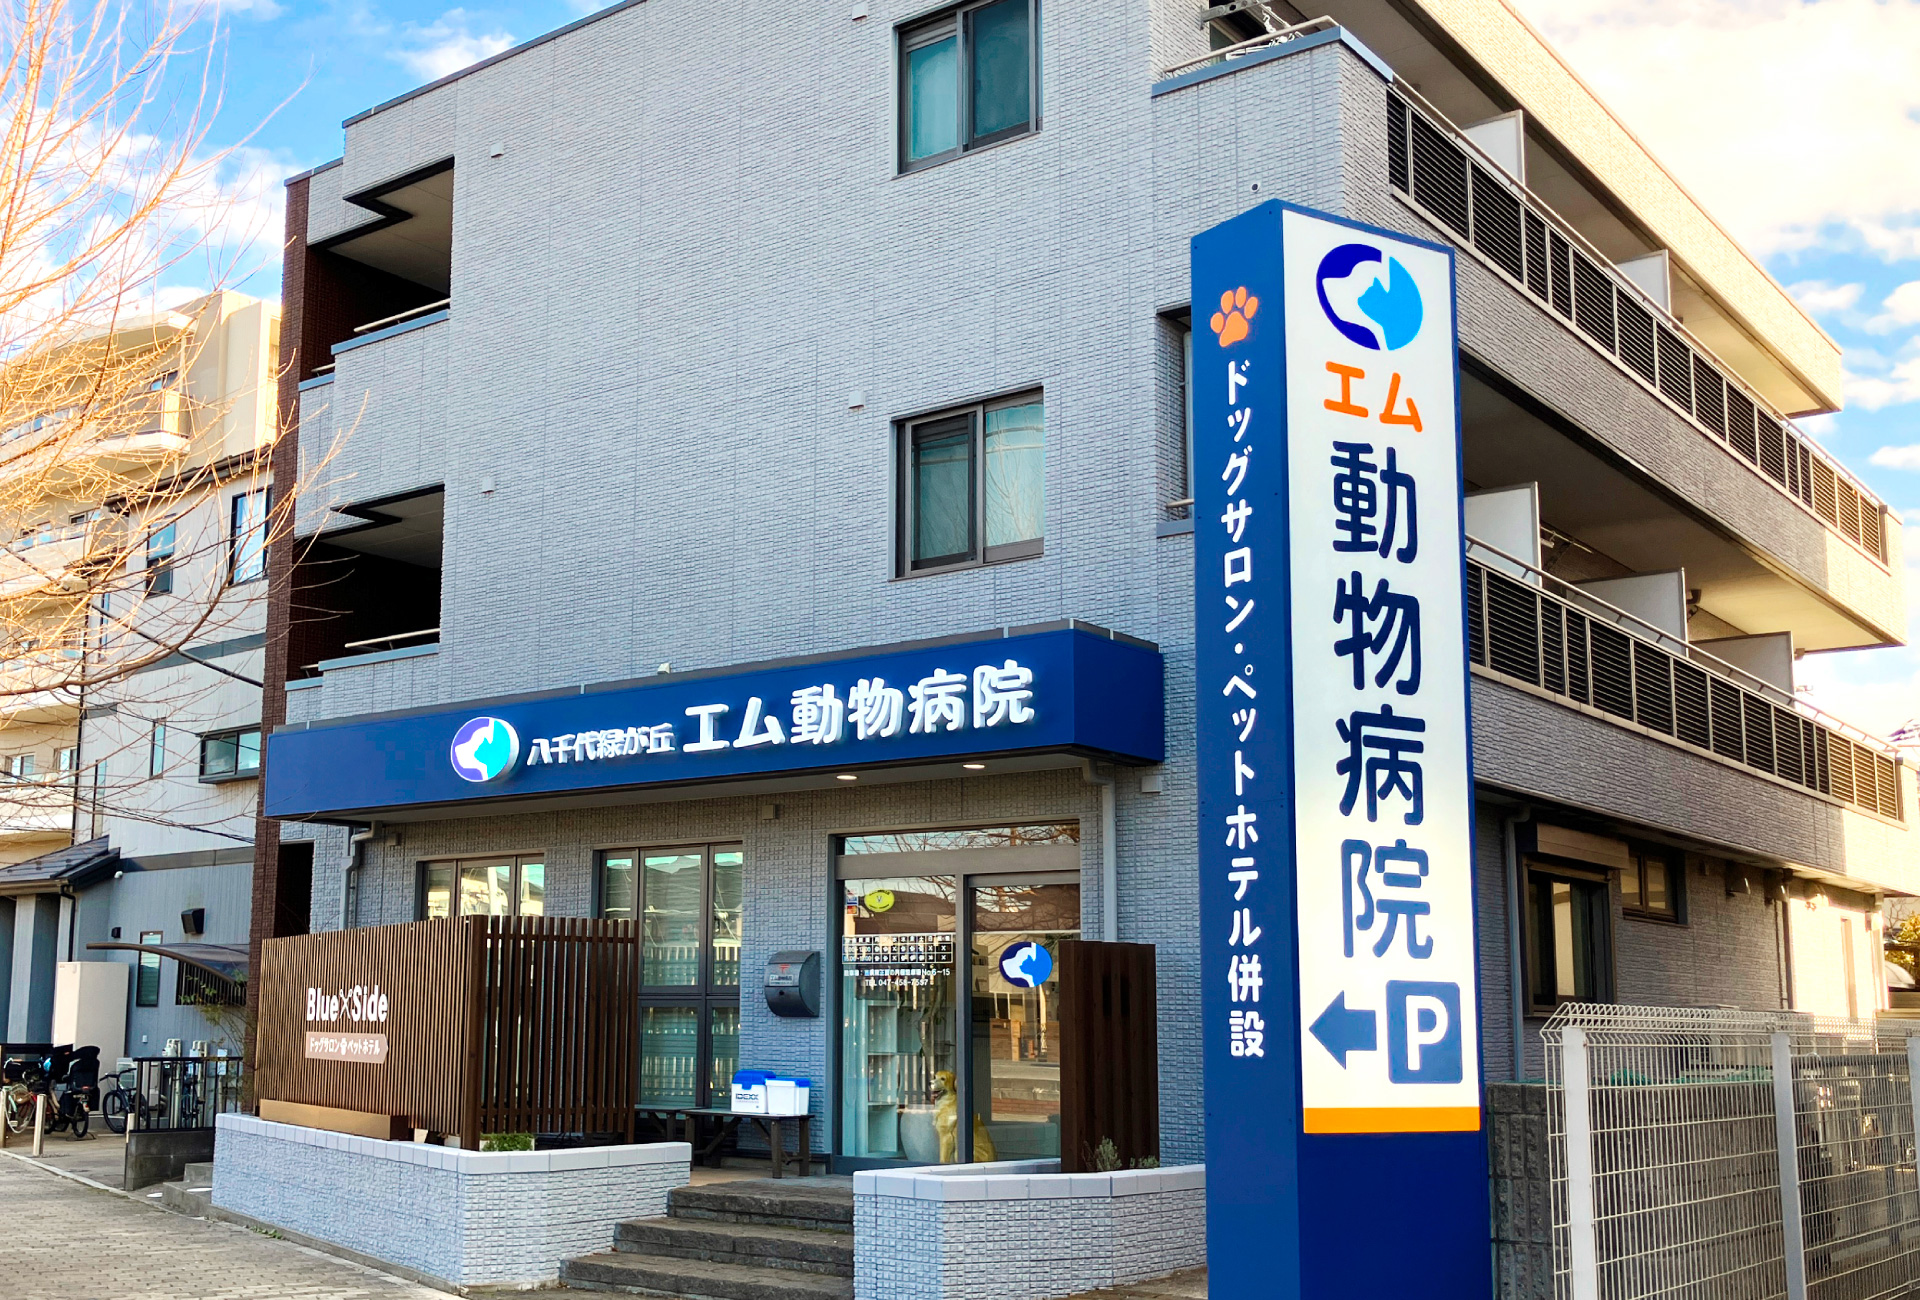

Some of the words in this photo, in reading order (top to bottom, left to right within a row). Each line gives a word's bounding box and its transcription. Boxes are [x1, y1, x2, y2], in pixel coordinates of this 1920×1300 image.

[1323, 360, 1424, 433] エム
[526, 722, 676, 766] 八千代緑が丘
[683, 659, 1035, 753] エム動物病院
[1220, 359, 1265, 1058] ドッグサロン・ペットホテル併設
[1330, 440, 1434, 960] 動物病院
[306, 987, 339, 1022] Blue
[352, 984, 388, 1023] Side
[1405, 994, 1449, 1071] P
[347, 1038, 381, 1055] ペットホテル
[735, 1093, 759, 1101] IDEXX
